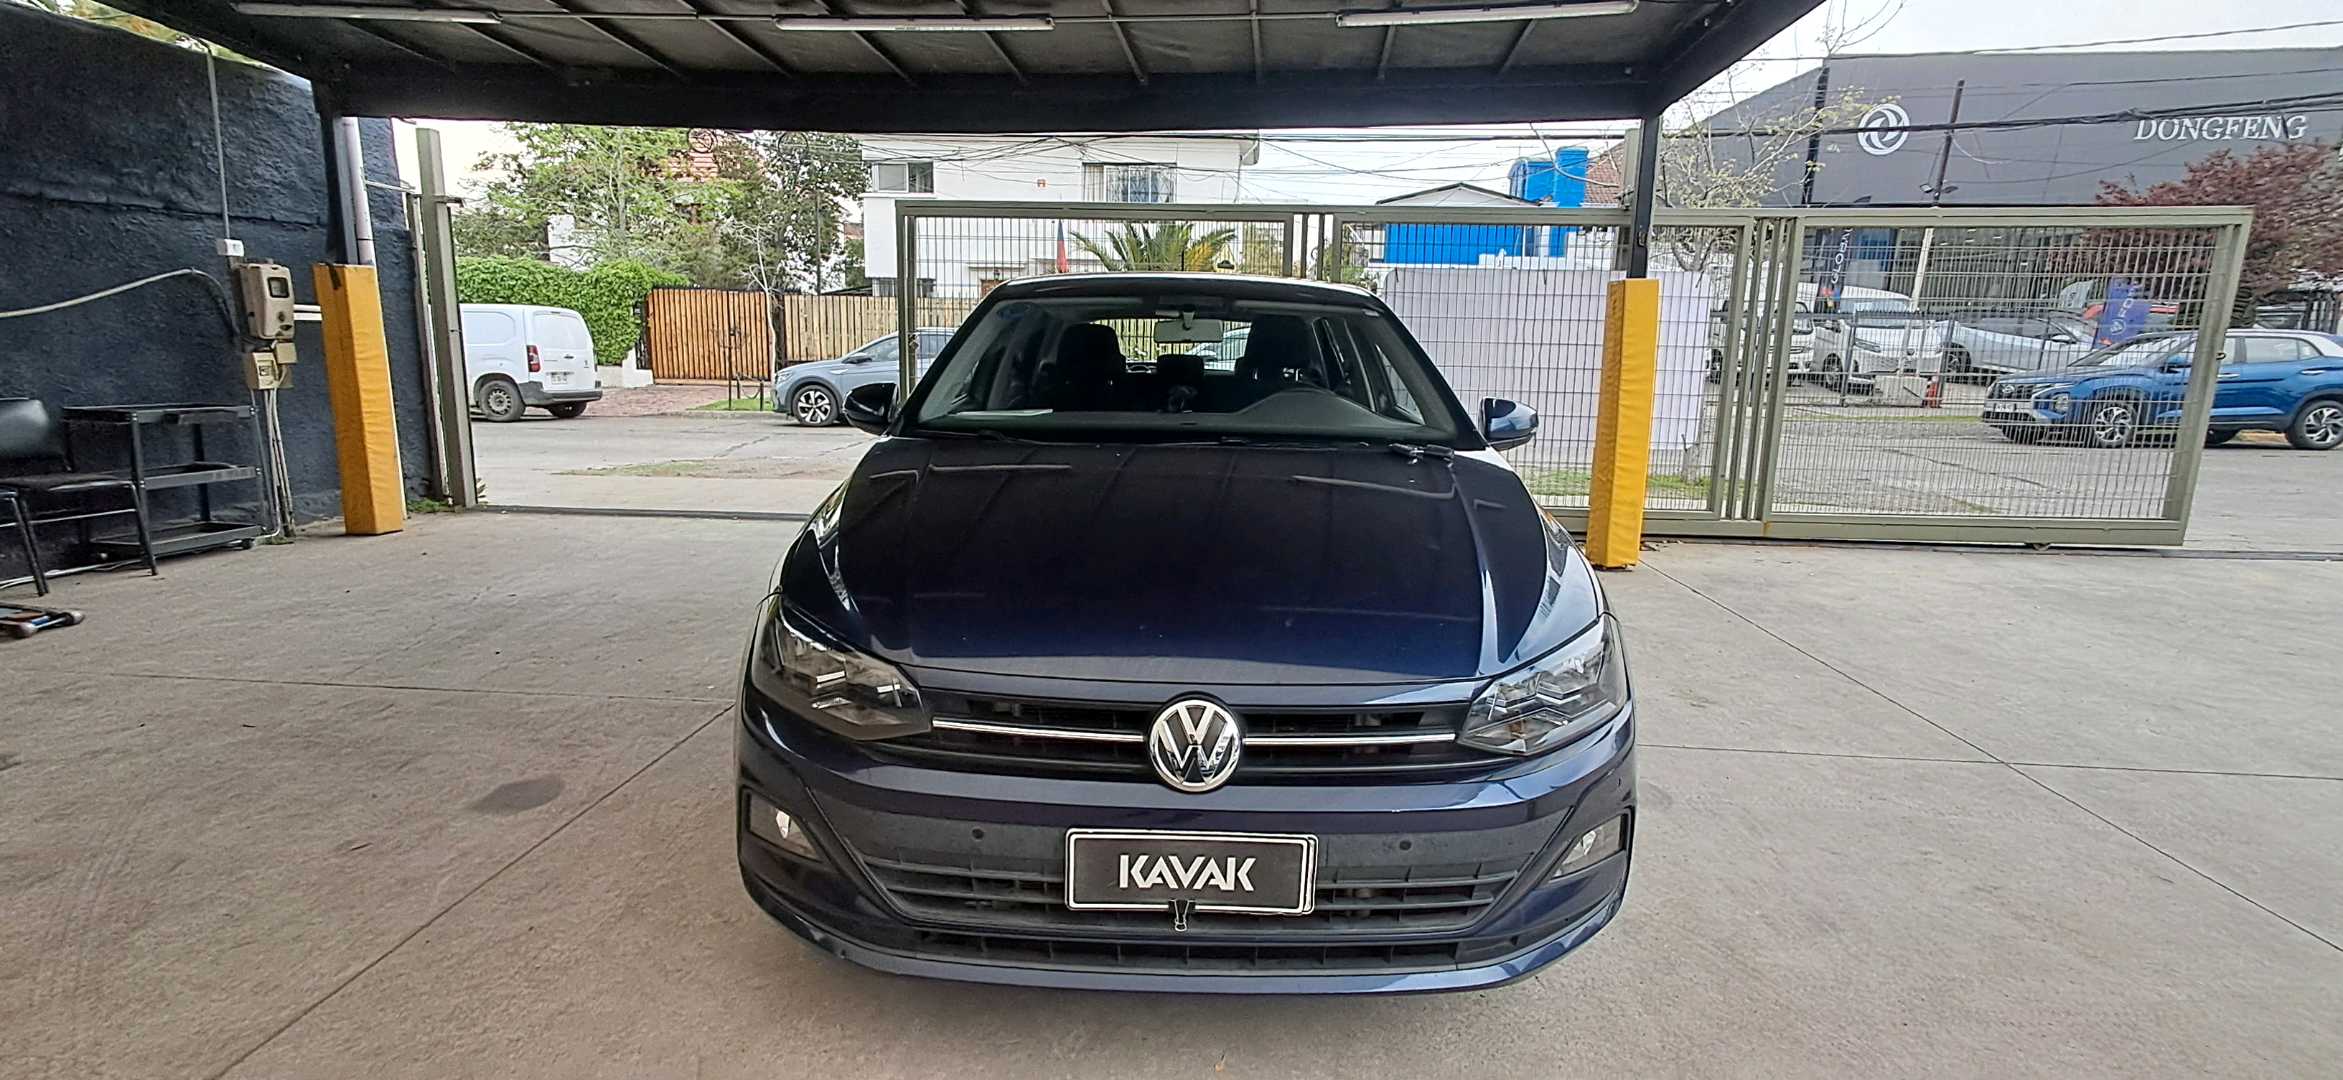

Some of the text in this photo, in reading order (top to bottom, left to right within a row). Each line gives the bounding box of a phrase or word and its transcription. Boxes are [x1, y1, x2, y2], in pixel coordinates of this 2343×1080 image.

[2134, 115, 2308, 141] DONGFENG
[1151, 699, 1241, 791] VW
[1119, 854, 1257, 892] KAVAK
